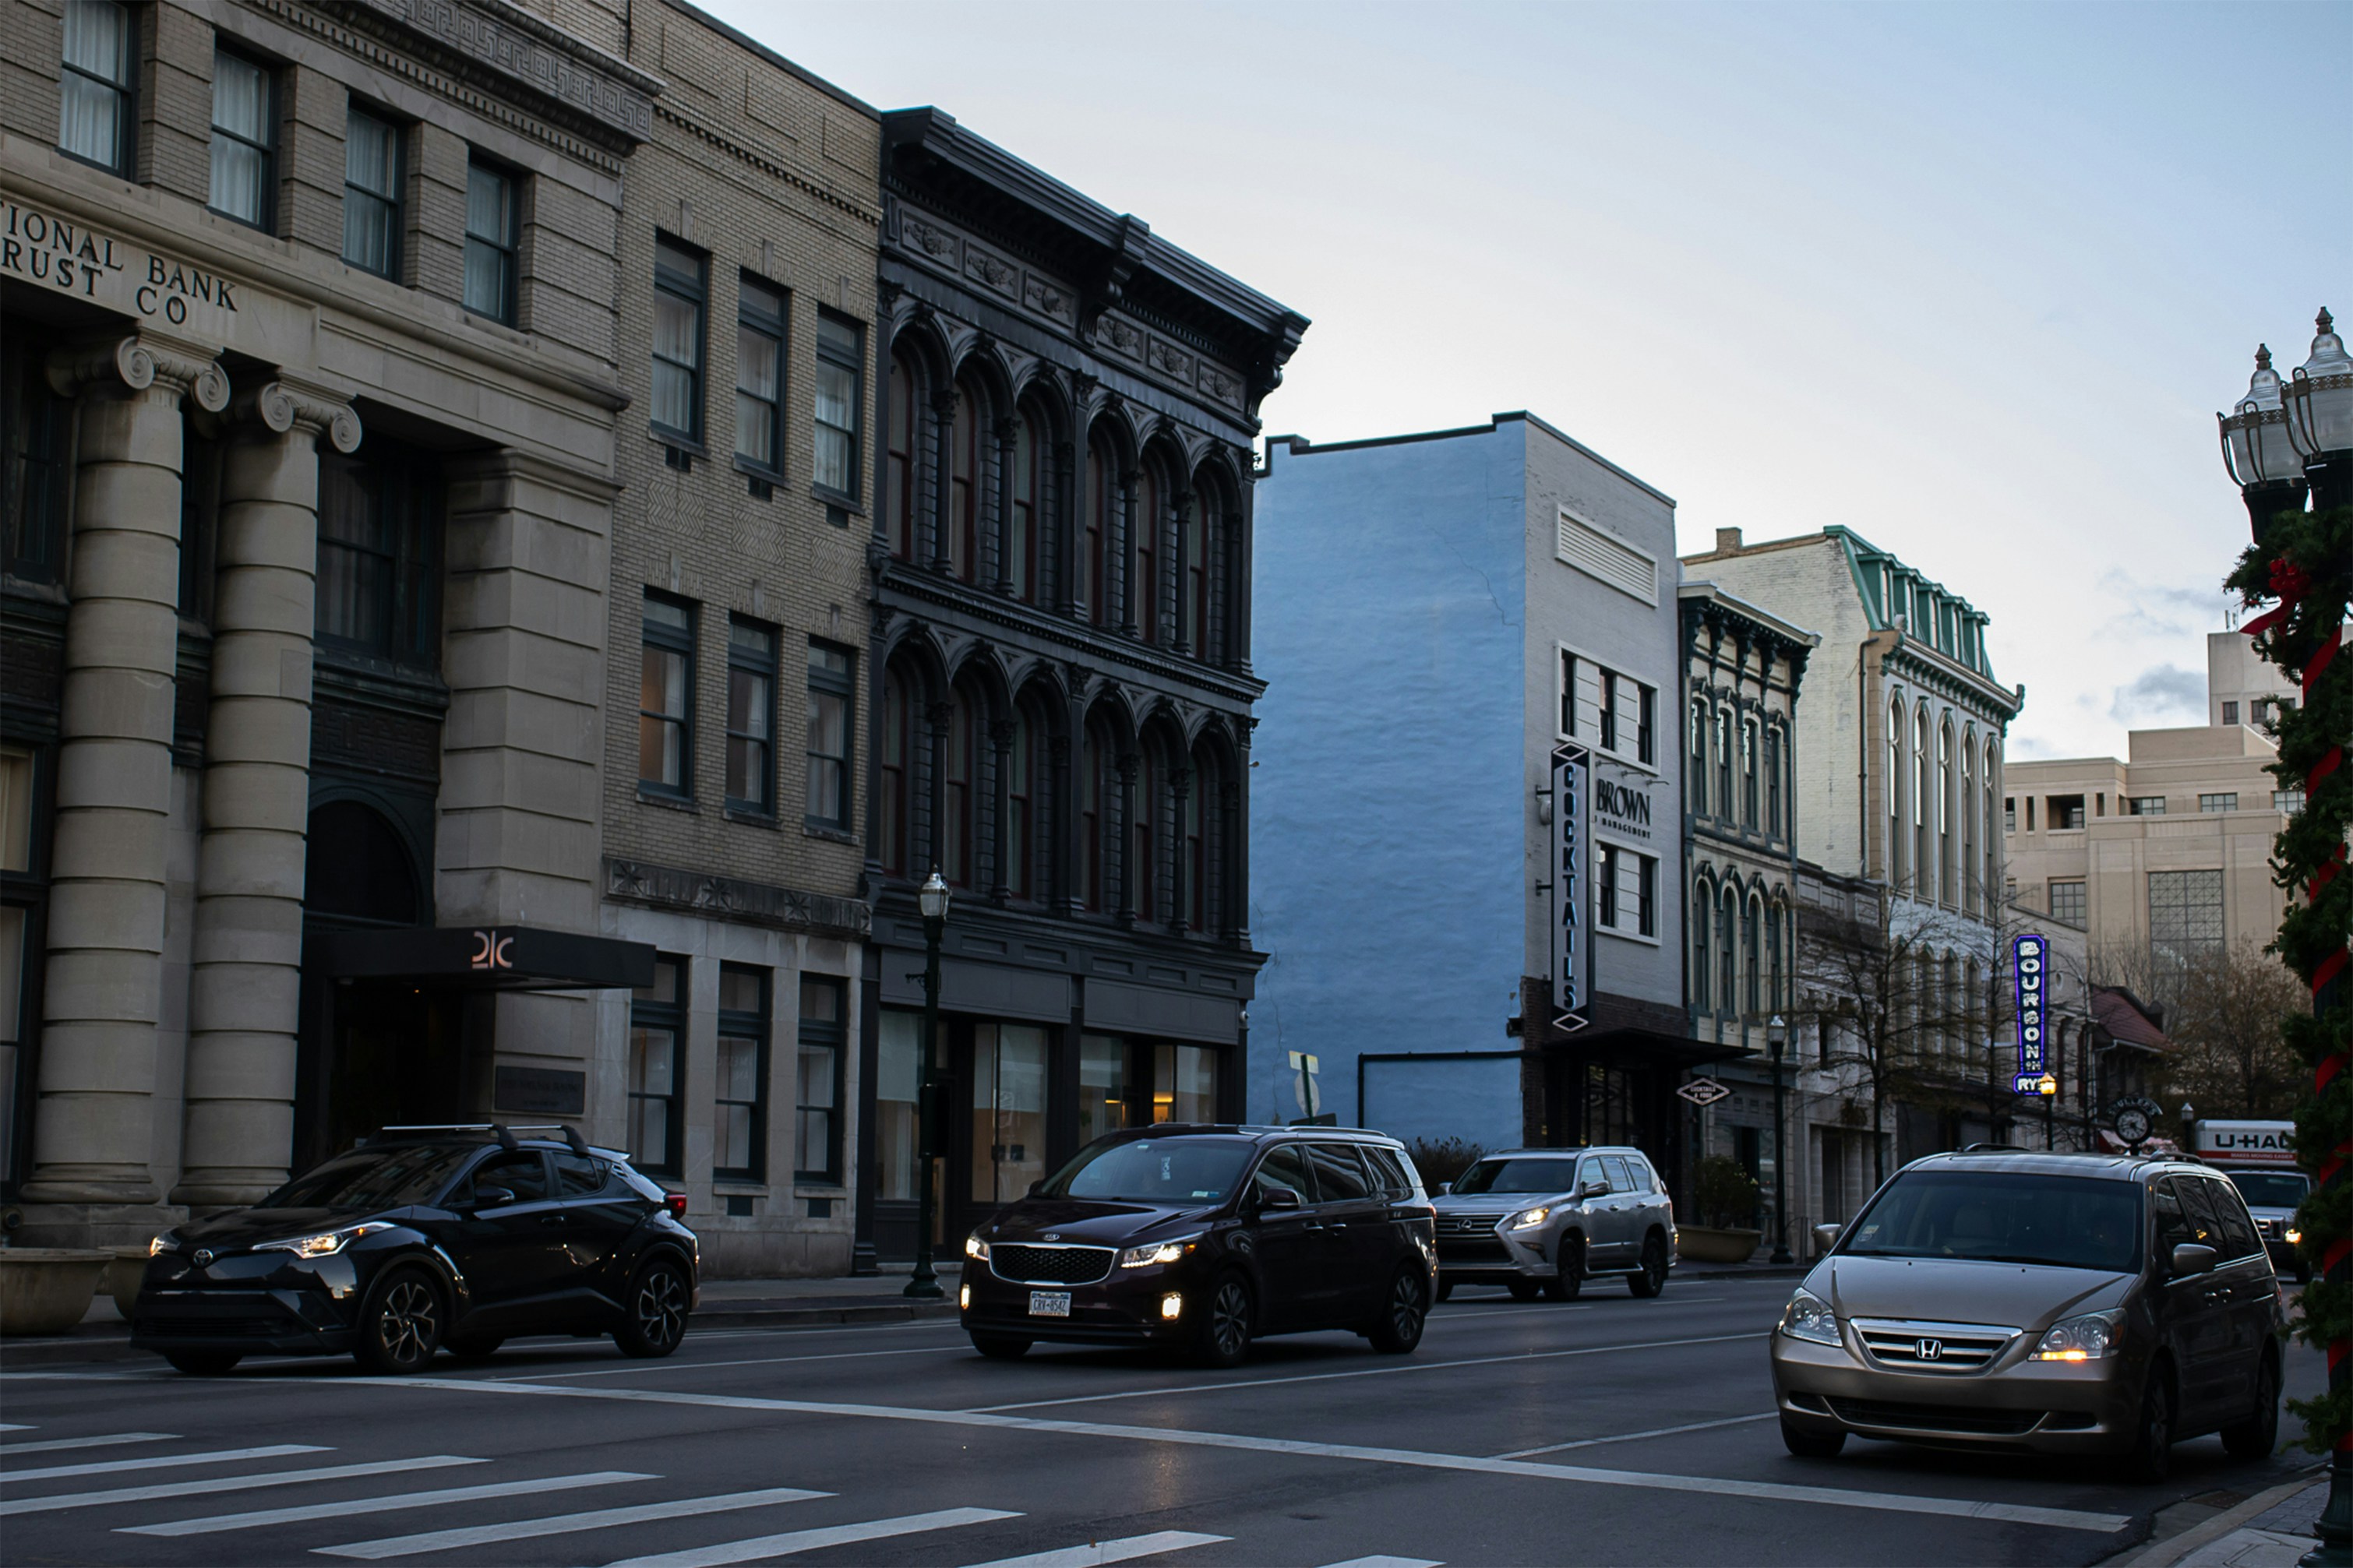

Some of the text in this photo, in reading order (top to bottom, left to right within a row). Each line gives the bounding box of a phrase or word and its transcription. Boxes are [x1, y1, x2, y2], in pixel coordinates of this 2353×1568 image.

[0, 201, 238, 312] IONAL BANK
[136, 286, 187, 325] CO
[1596, 777, 1650, 826] BROWN
[1562, 764, 1578, 1010] COCKTAILS
[2020, 941, 2040, 1059] BOURBON
